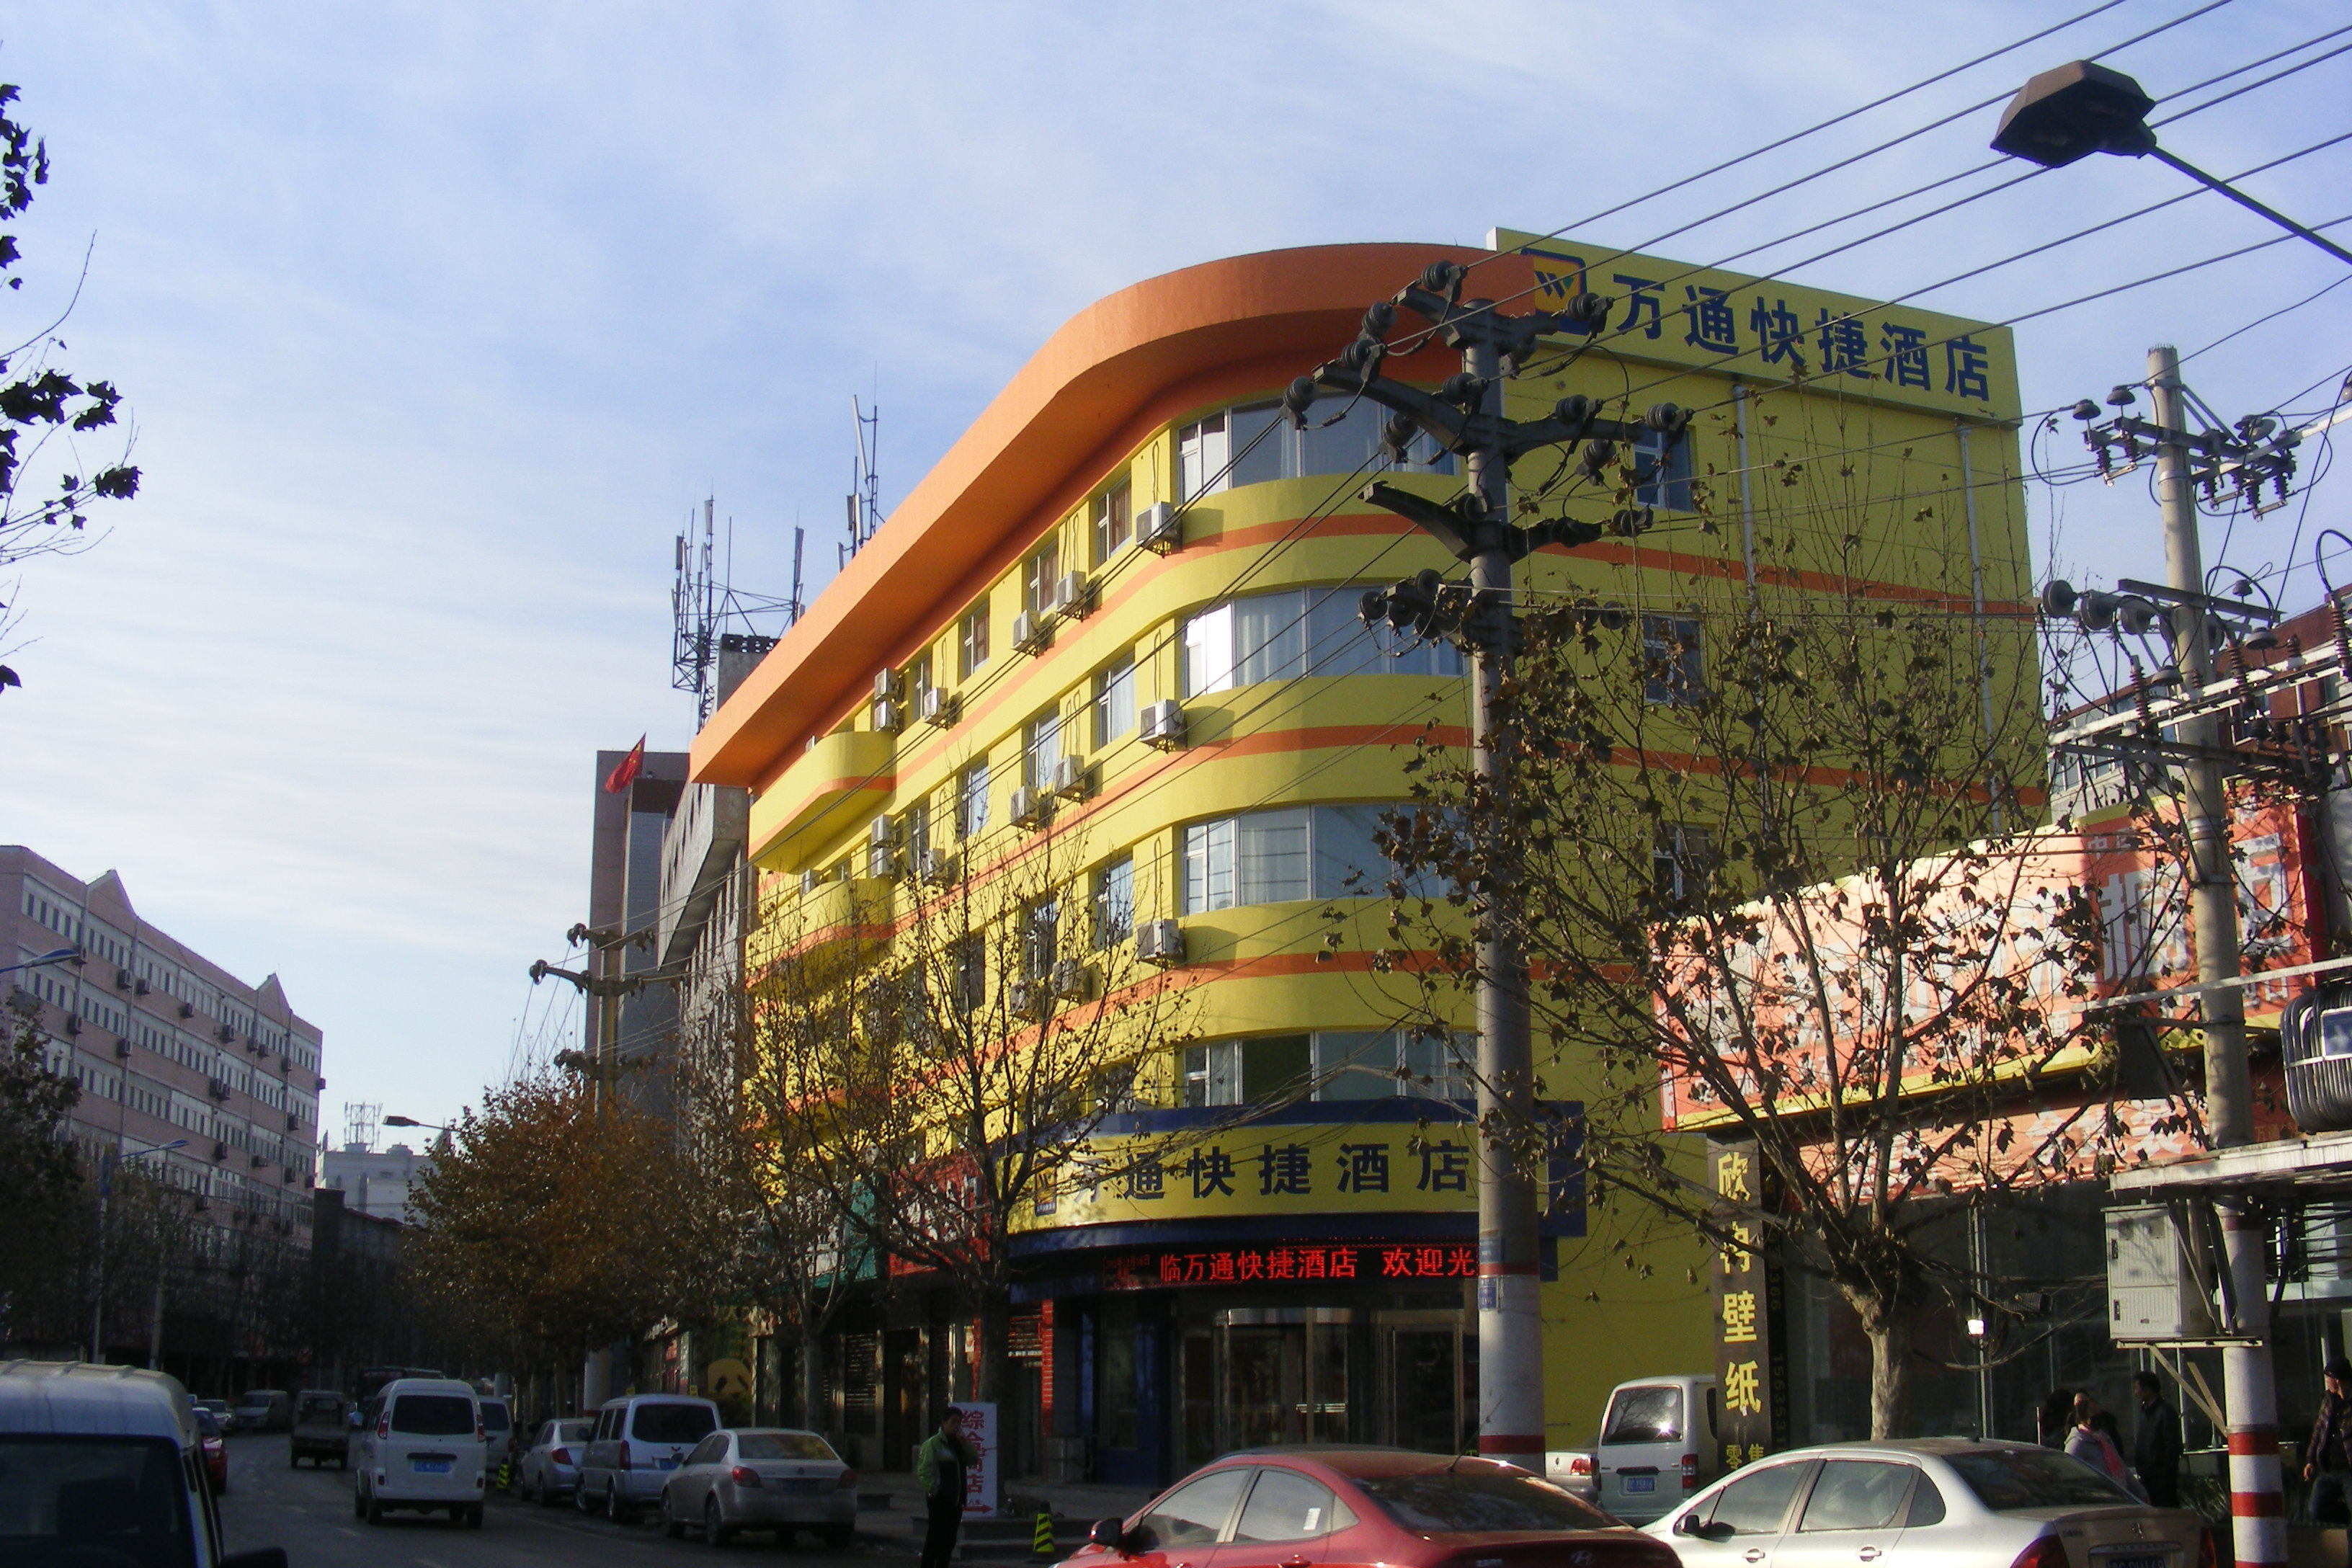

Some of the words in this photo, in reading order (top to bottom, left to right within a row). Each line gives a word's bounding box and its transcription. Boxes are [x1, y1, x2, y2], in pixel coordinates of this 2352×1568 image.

[1613, 272, 1990, 402] 万通快捷酒店
[1159, 1247, 1358, 1282] 临万通快捷酒店
[1381, 1247, 1476, 1279] 欢迎光
